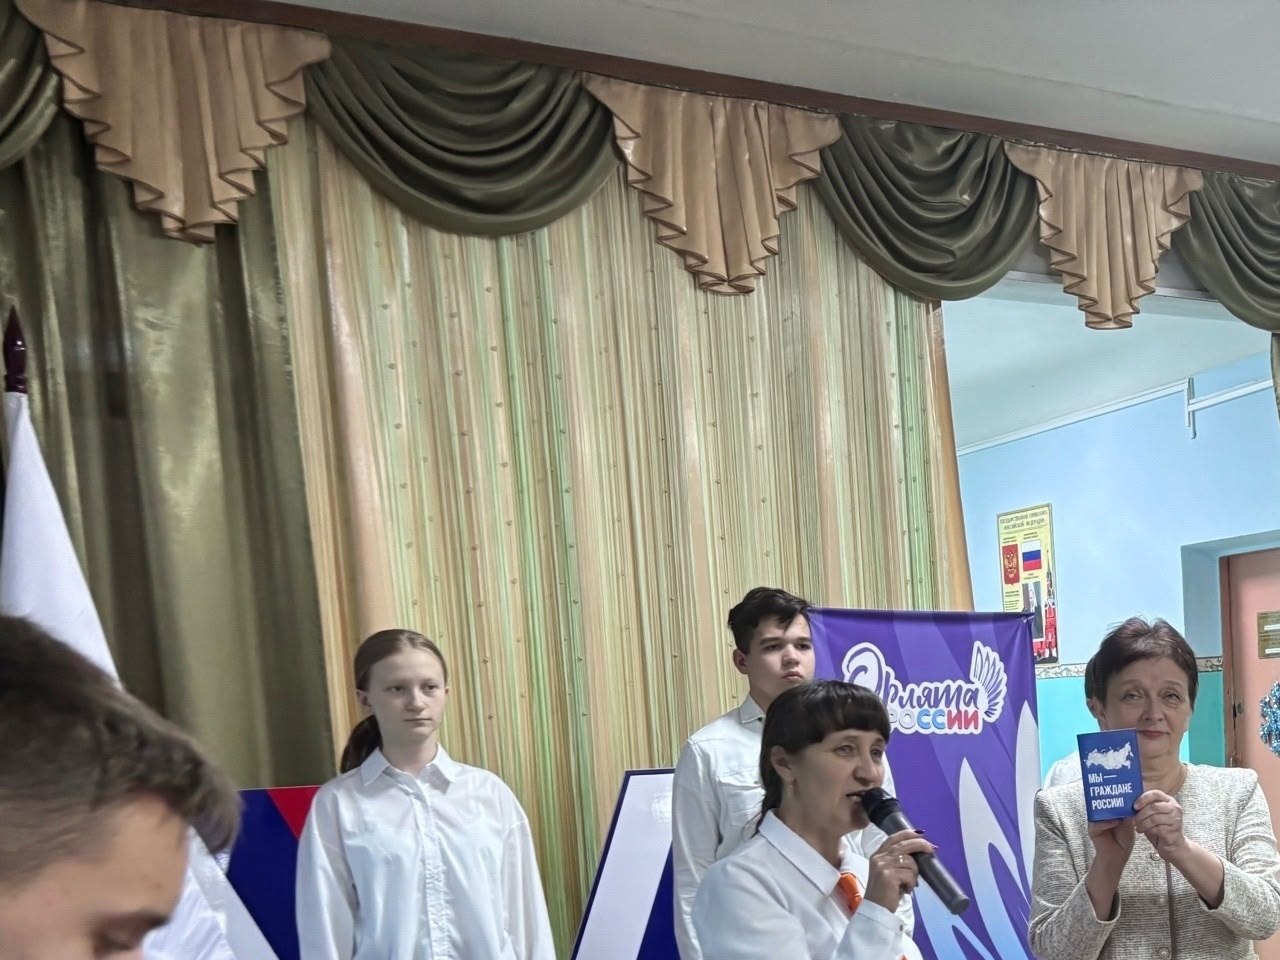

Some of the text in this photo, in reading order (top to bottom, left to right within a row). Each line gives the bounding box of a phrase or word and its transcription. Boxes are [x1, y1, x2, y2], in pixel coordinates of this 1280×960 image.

[846, 646, 980, 713] Орлята
[1088, 773, 1103, 783] МЫ
[1090, 783, 1133, 797] ГРАЖДАНЕ
[1092, 797, 1125, 810] РОССИИ!
